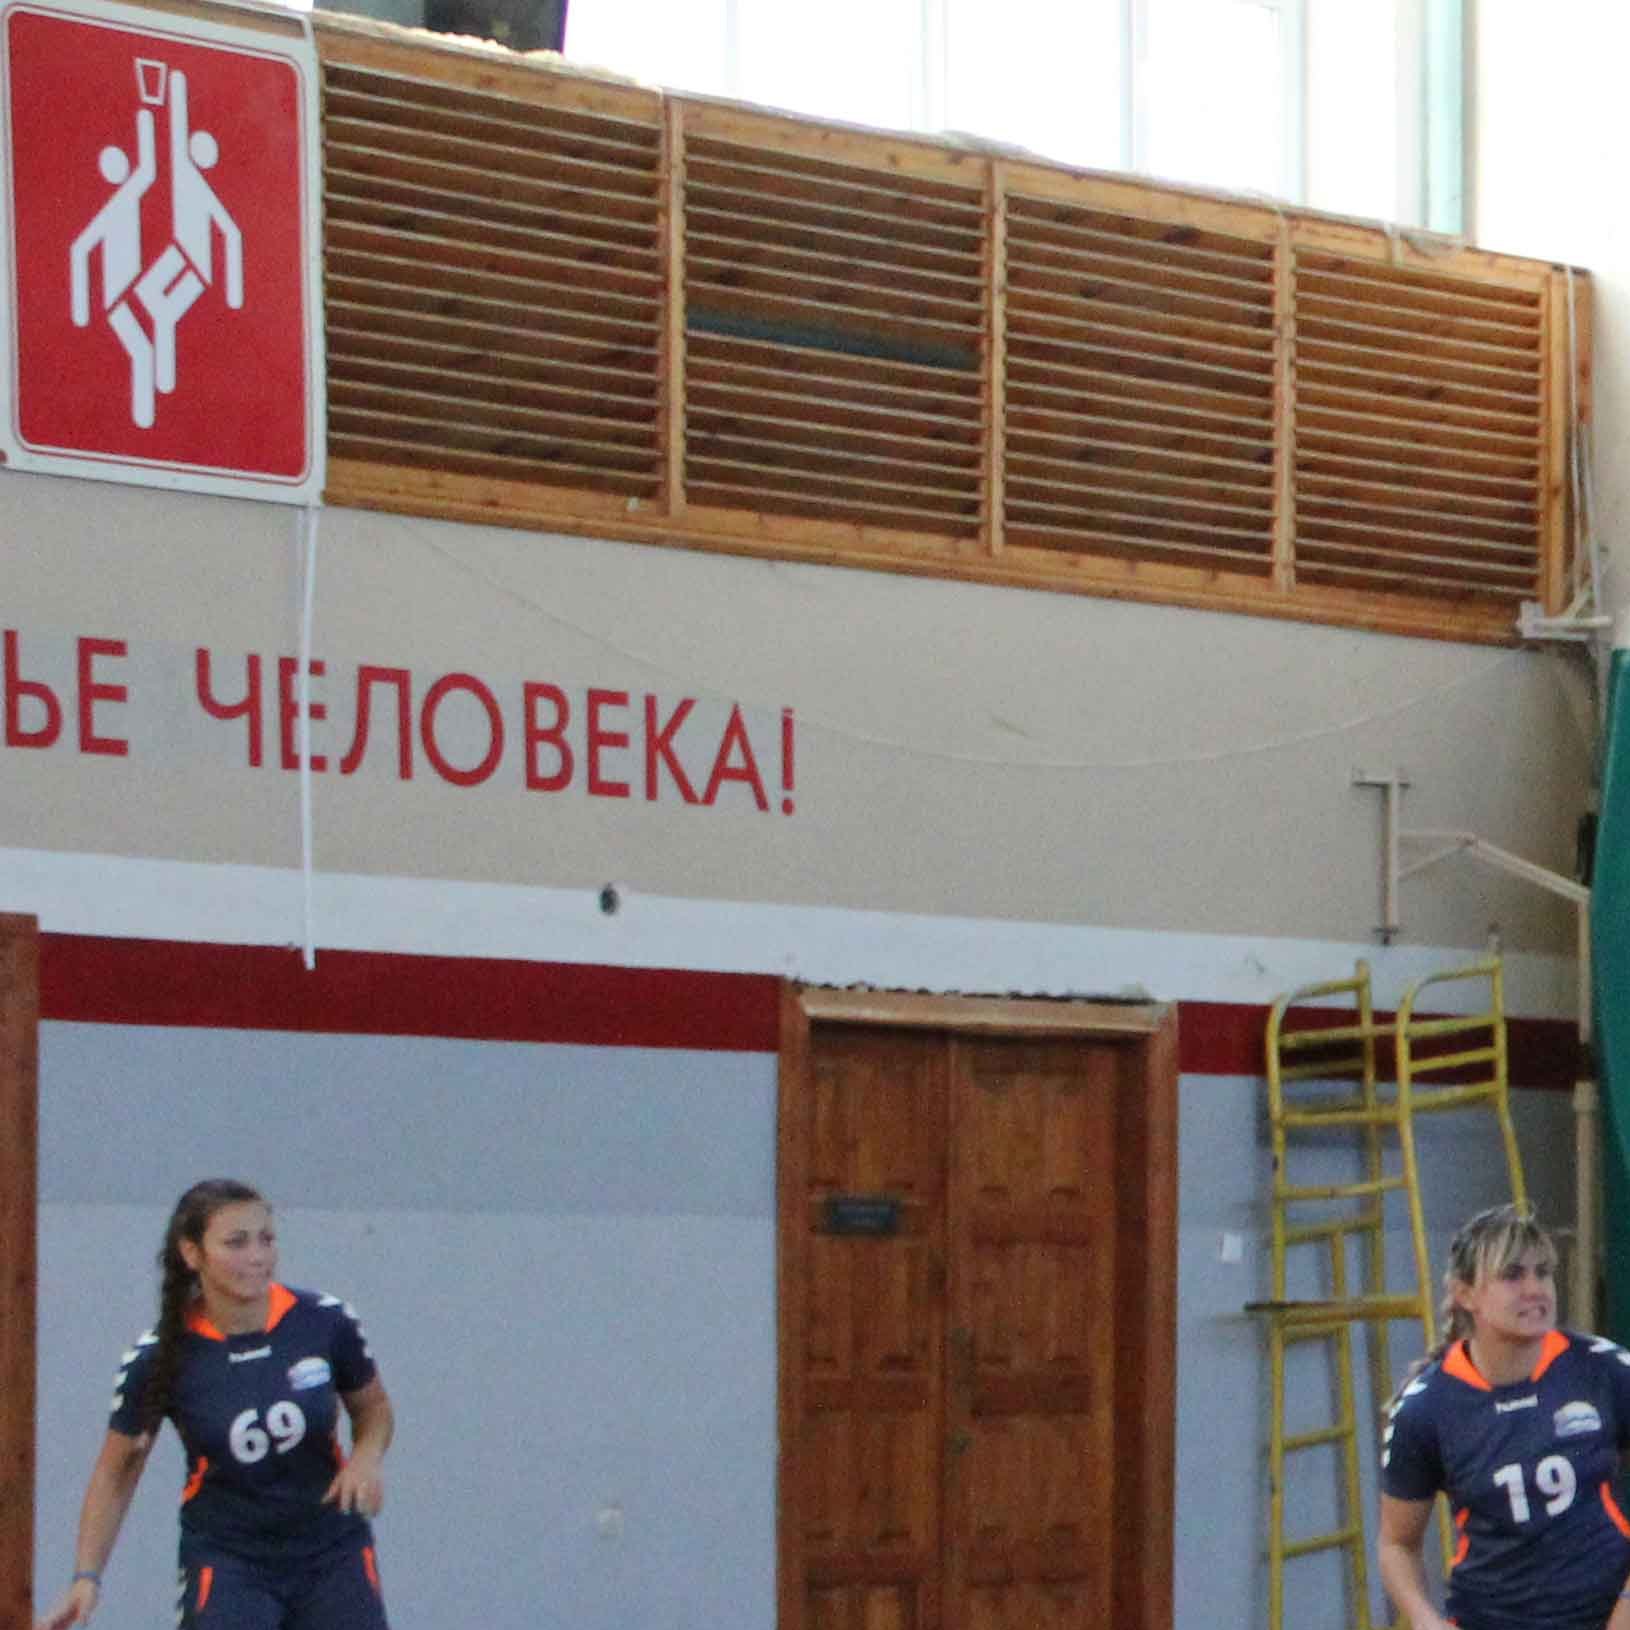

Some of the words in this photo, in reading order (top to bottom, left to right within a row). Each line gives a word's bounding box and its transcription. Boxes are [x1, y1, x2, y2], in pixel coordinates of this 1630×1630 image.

[195, 647, 796, 815] ЧЕЛОВЕКА!
[228, 1399, 307, 1463] 69
[1492, 1454, 1578, 1524] 19
